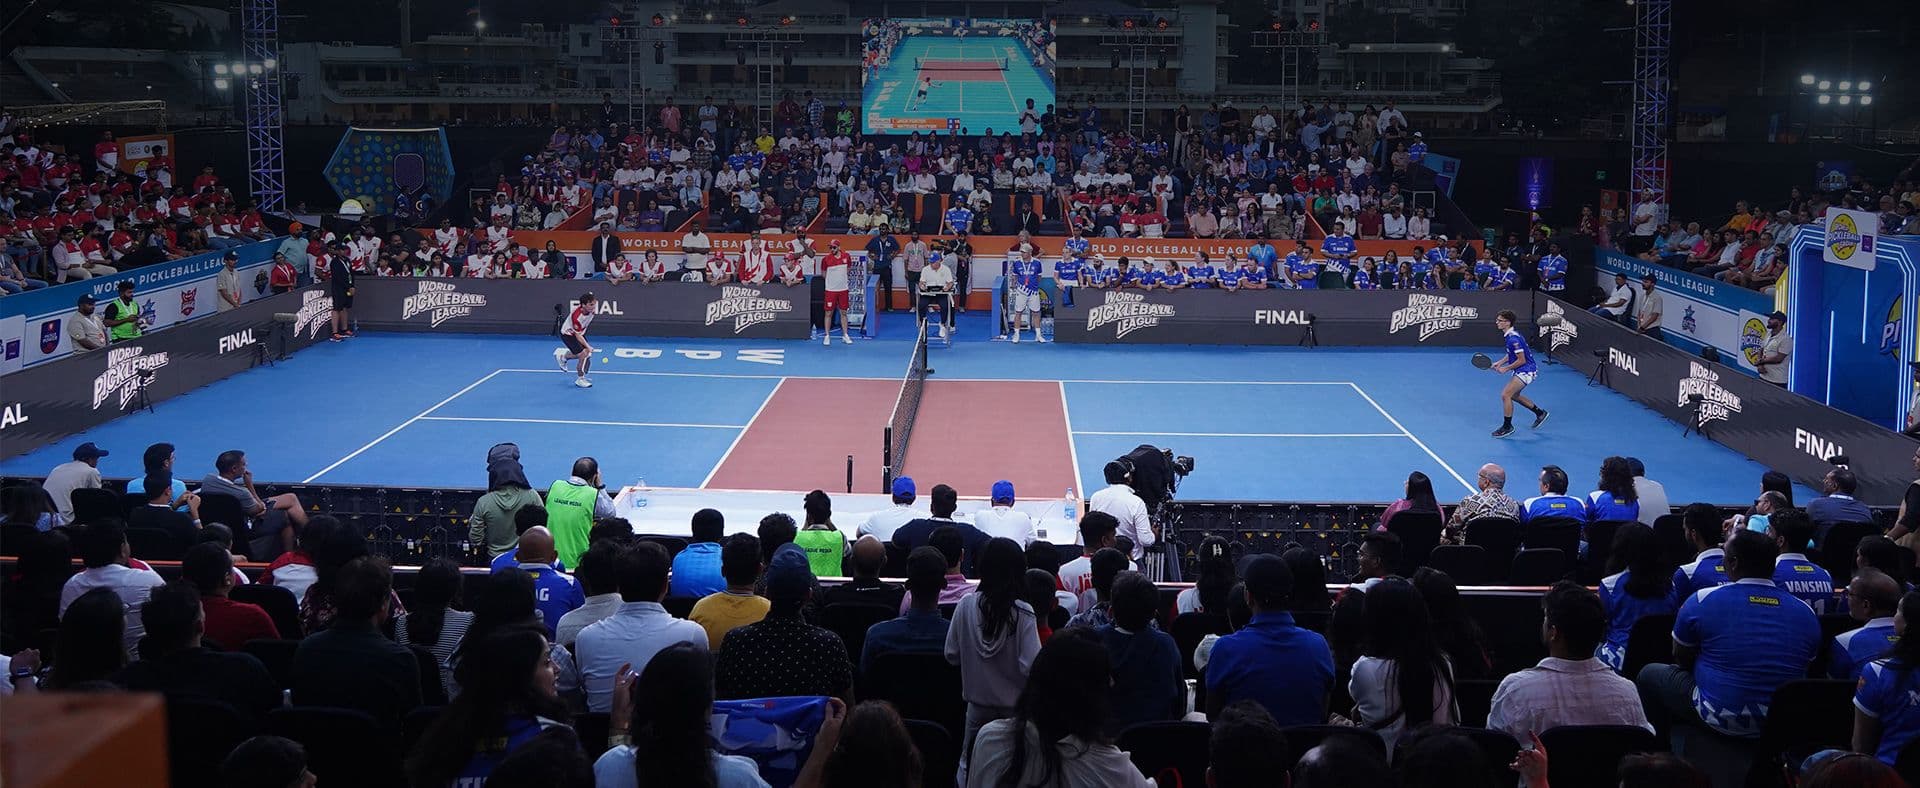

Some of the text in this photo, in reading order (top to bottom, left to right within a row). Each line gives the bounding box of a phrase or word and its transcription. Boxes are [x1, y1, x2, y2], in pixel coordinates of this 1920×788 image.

[622, 239, 673, 248] WORLD
[1091, 245, 1250, 254] RLD PICKLEBALL LEAGU
[93, 277, 134, 295] WORD
[139, 261, 201, 285] PICKLEBALL
[418, 280, 456, 293] WORLD
[1607, 256, 1631, 271] WORLD
[1681, 277, 1715, 296] LEAGUE
[302, 289, 325, 304] WORLD
[722, 286, 761, 299] WORLD
[1105, 291, 1144, 304] WORLD
[1408, 293, 1448, 306] WORLD
[294, 296, 334, 337] PICKLEBA
[402, 291, 487, 320] PICKLEBALL
[569, 299, 624, 316] FAL
[705, 297, 792, 326] PICKLEBALL
[1087, 302, 1176, 331] PICKLEBALL
[430, 306, 472, 328] LEAGUE
[734, 312, 776, 334] LEAGUE
[1116, 317, 1160, 339] LEAGUE
[1255, 309, 1310, 325] FINAL
[1389, 304, 1479, 334] PICKLEBALL
[219, 328, 257, 354] FINAL
[1418, 319, 1463, 342] LEAGUE
[107, 346, 143, 366] WORLD
[1608, 347, 1640, 377] FINAL
[93, 351, 169, 410] PICKLEBALL
[1689, 361, 1719, 382] WORLD
[1678, 377, 1742, 413] PICKLEBALL
[1698, 402, 1729, 427] LEAGUE
[1795, 427, 1849, 471] FINAL
